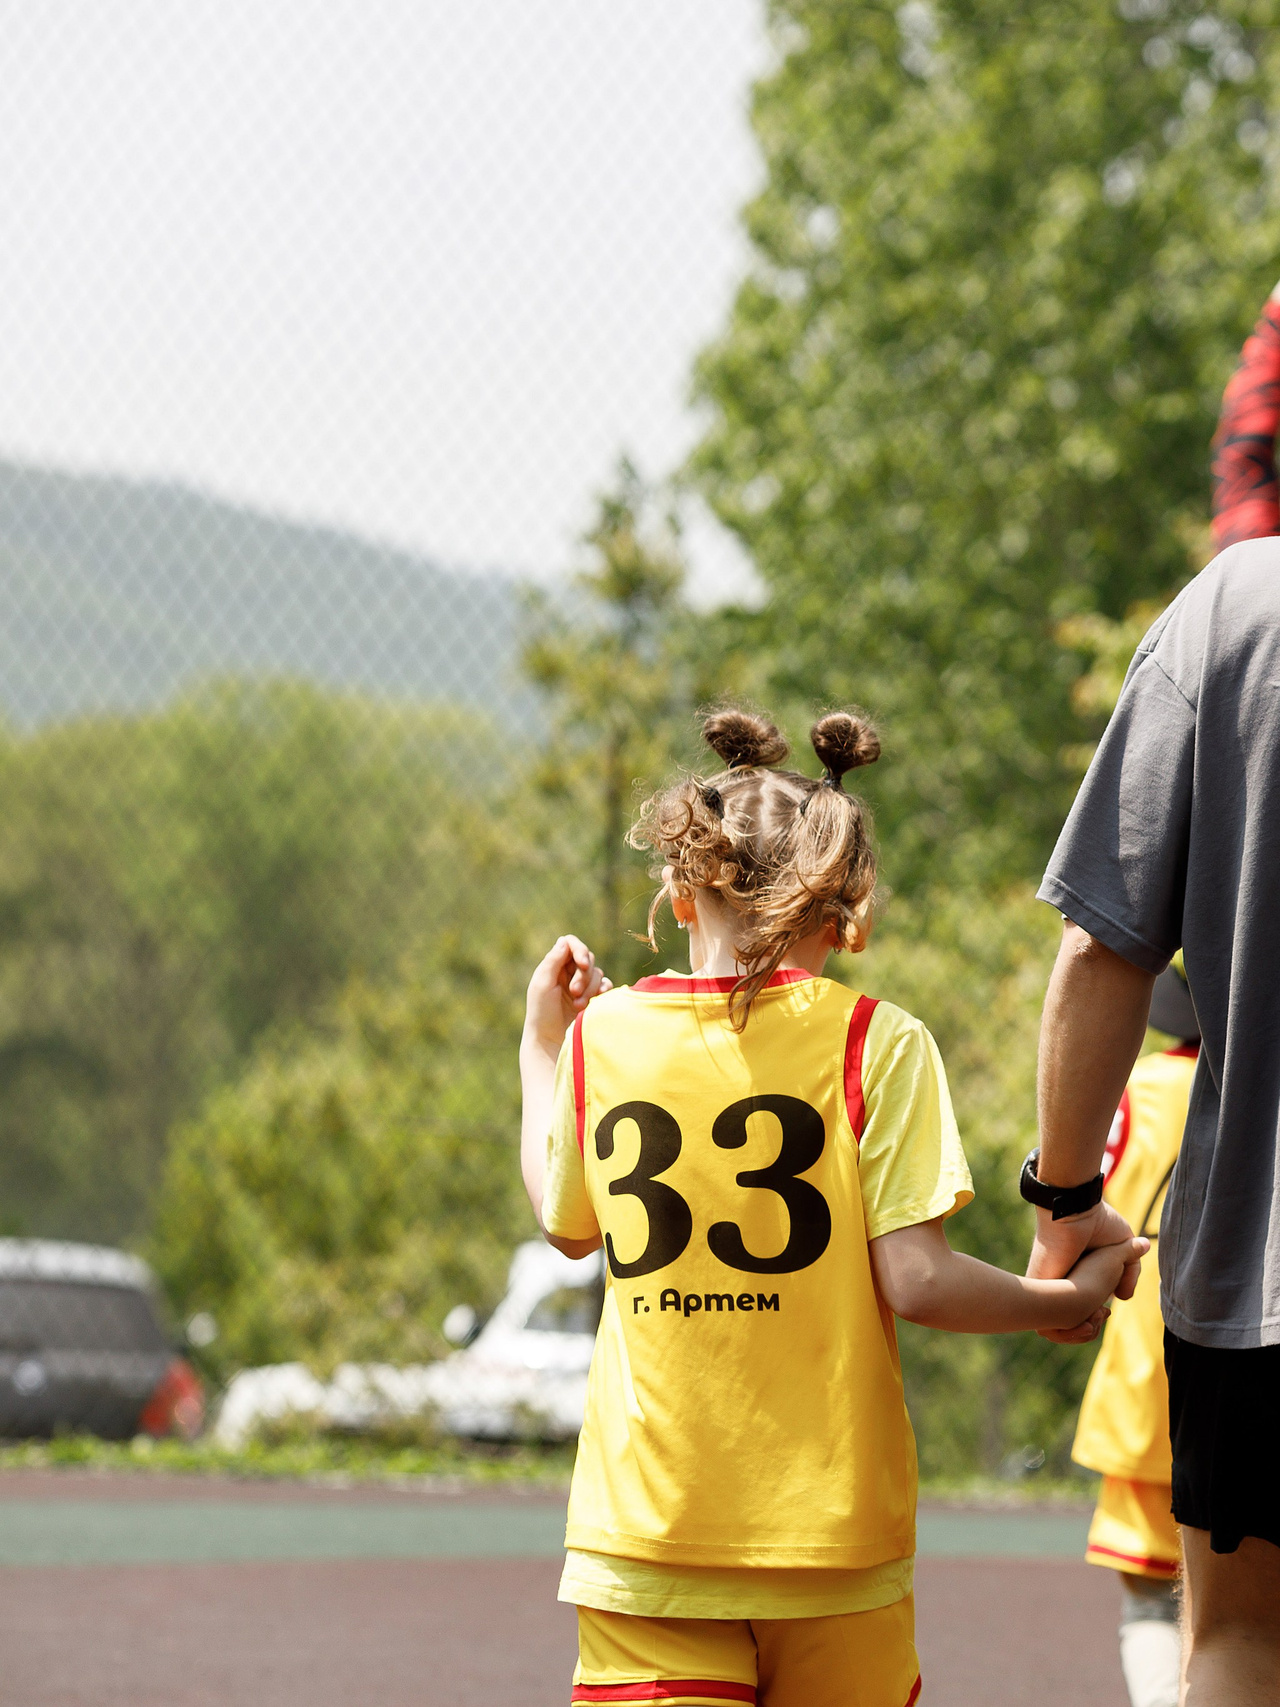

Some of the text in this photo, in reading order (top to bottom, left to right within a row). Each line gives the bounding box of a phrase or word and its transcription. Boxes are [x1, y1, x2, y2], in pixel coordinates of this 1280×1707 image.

[594, 1093, 832, 1279] 33
[633, 1288, 780, 1317] г. Артем
